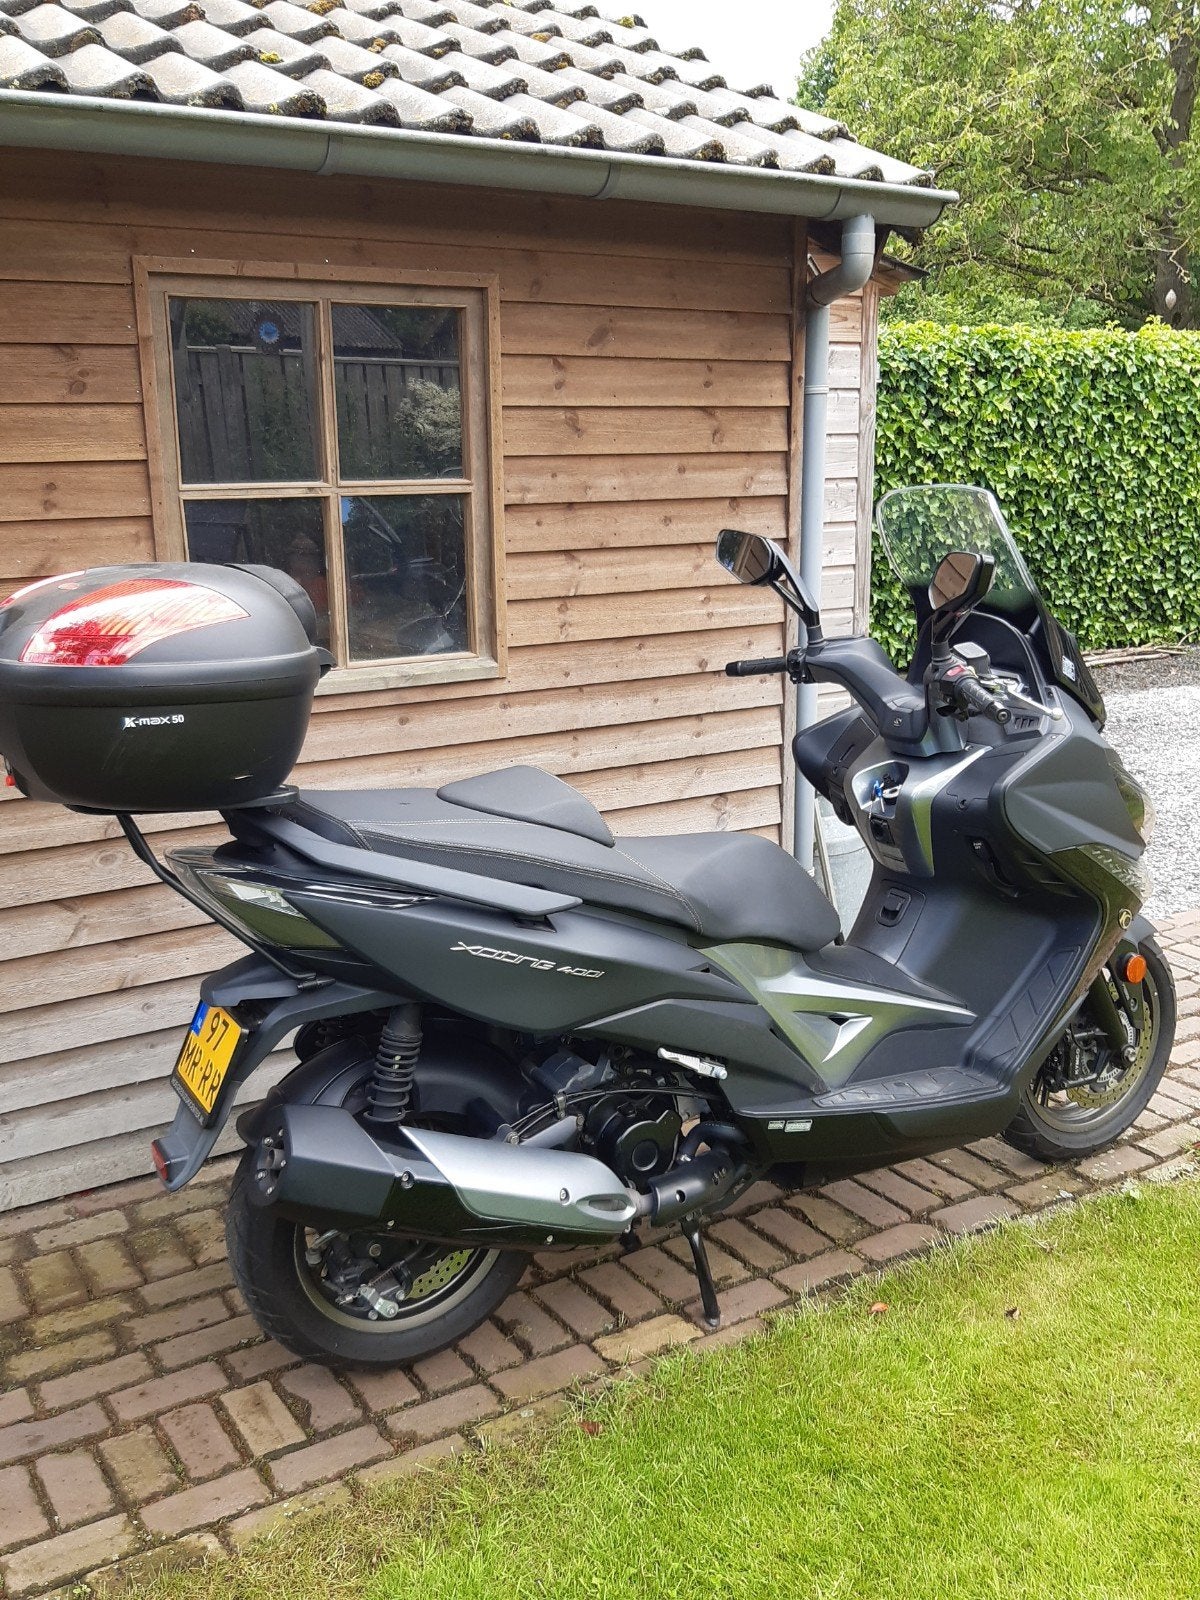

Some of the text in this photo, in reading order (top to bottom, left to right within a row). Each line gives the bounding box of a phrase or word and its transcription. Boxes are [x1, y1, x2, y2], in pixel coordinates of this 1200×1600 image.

[122, 714, 185, 731] K-max 50
[205, 1011, 230, 1051] 97
